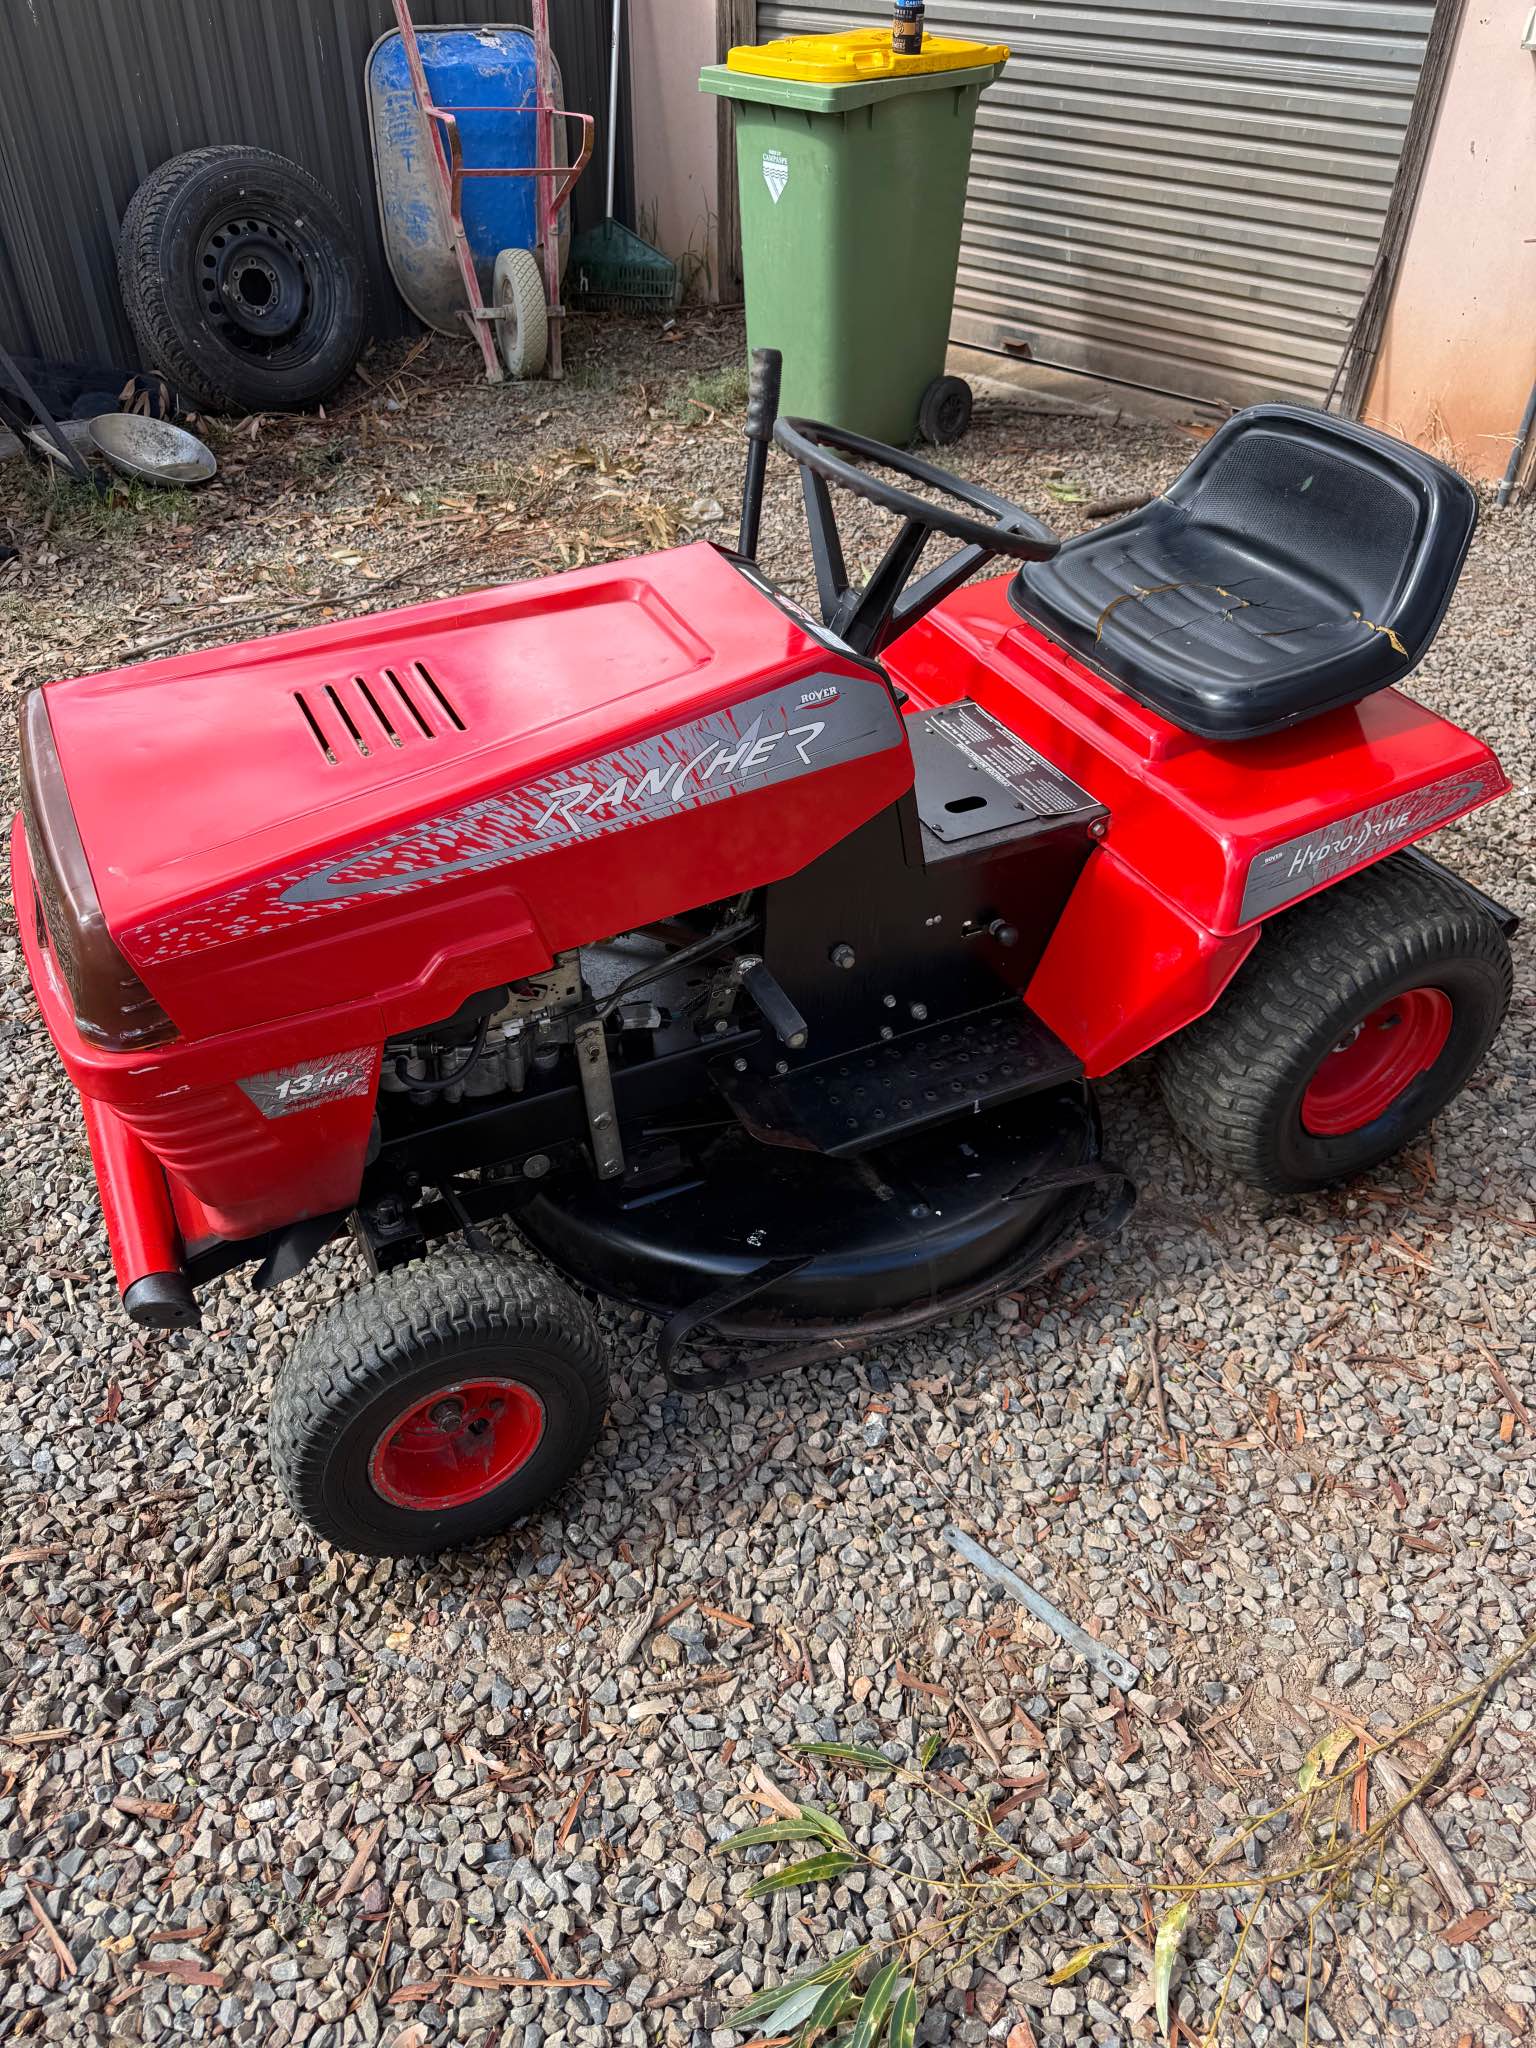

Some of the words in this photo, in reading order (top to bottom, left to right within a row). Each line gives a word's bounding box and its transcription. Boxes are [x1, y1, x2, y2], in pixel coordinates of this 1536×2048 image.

[801, 686, 838, 703] ROVER
[532, 721, 826, 833] RANCHER
[275, 1074, 314, 1099] 13
[319, 1071, 348, 1088] HP
